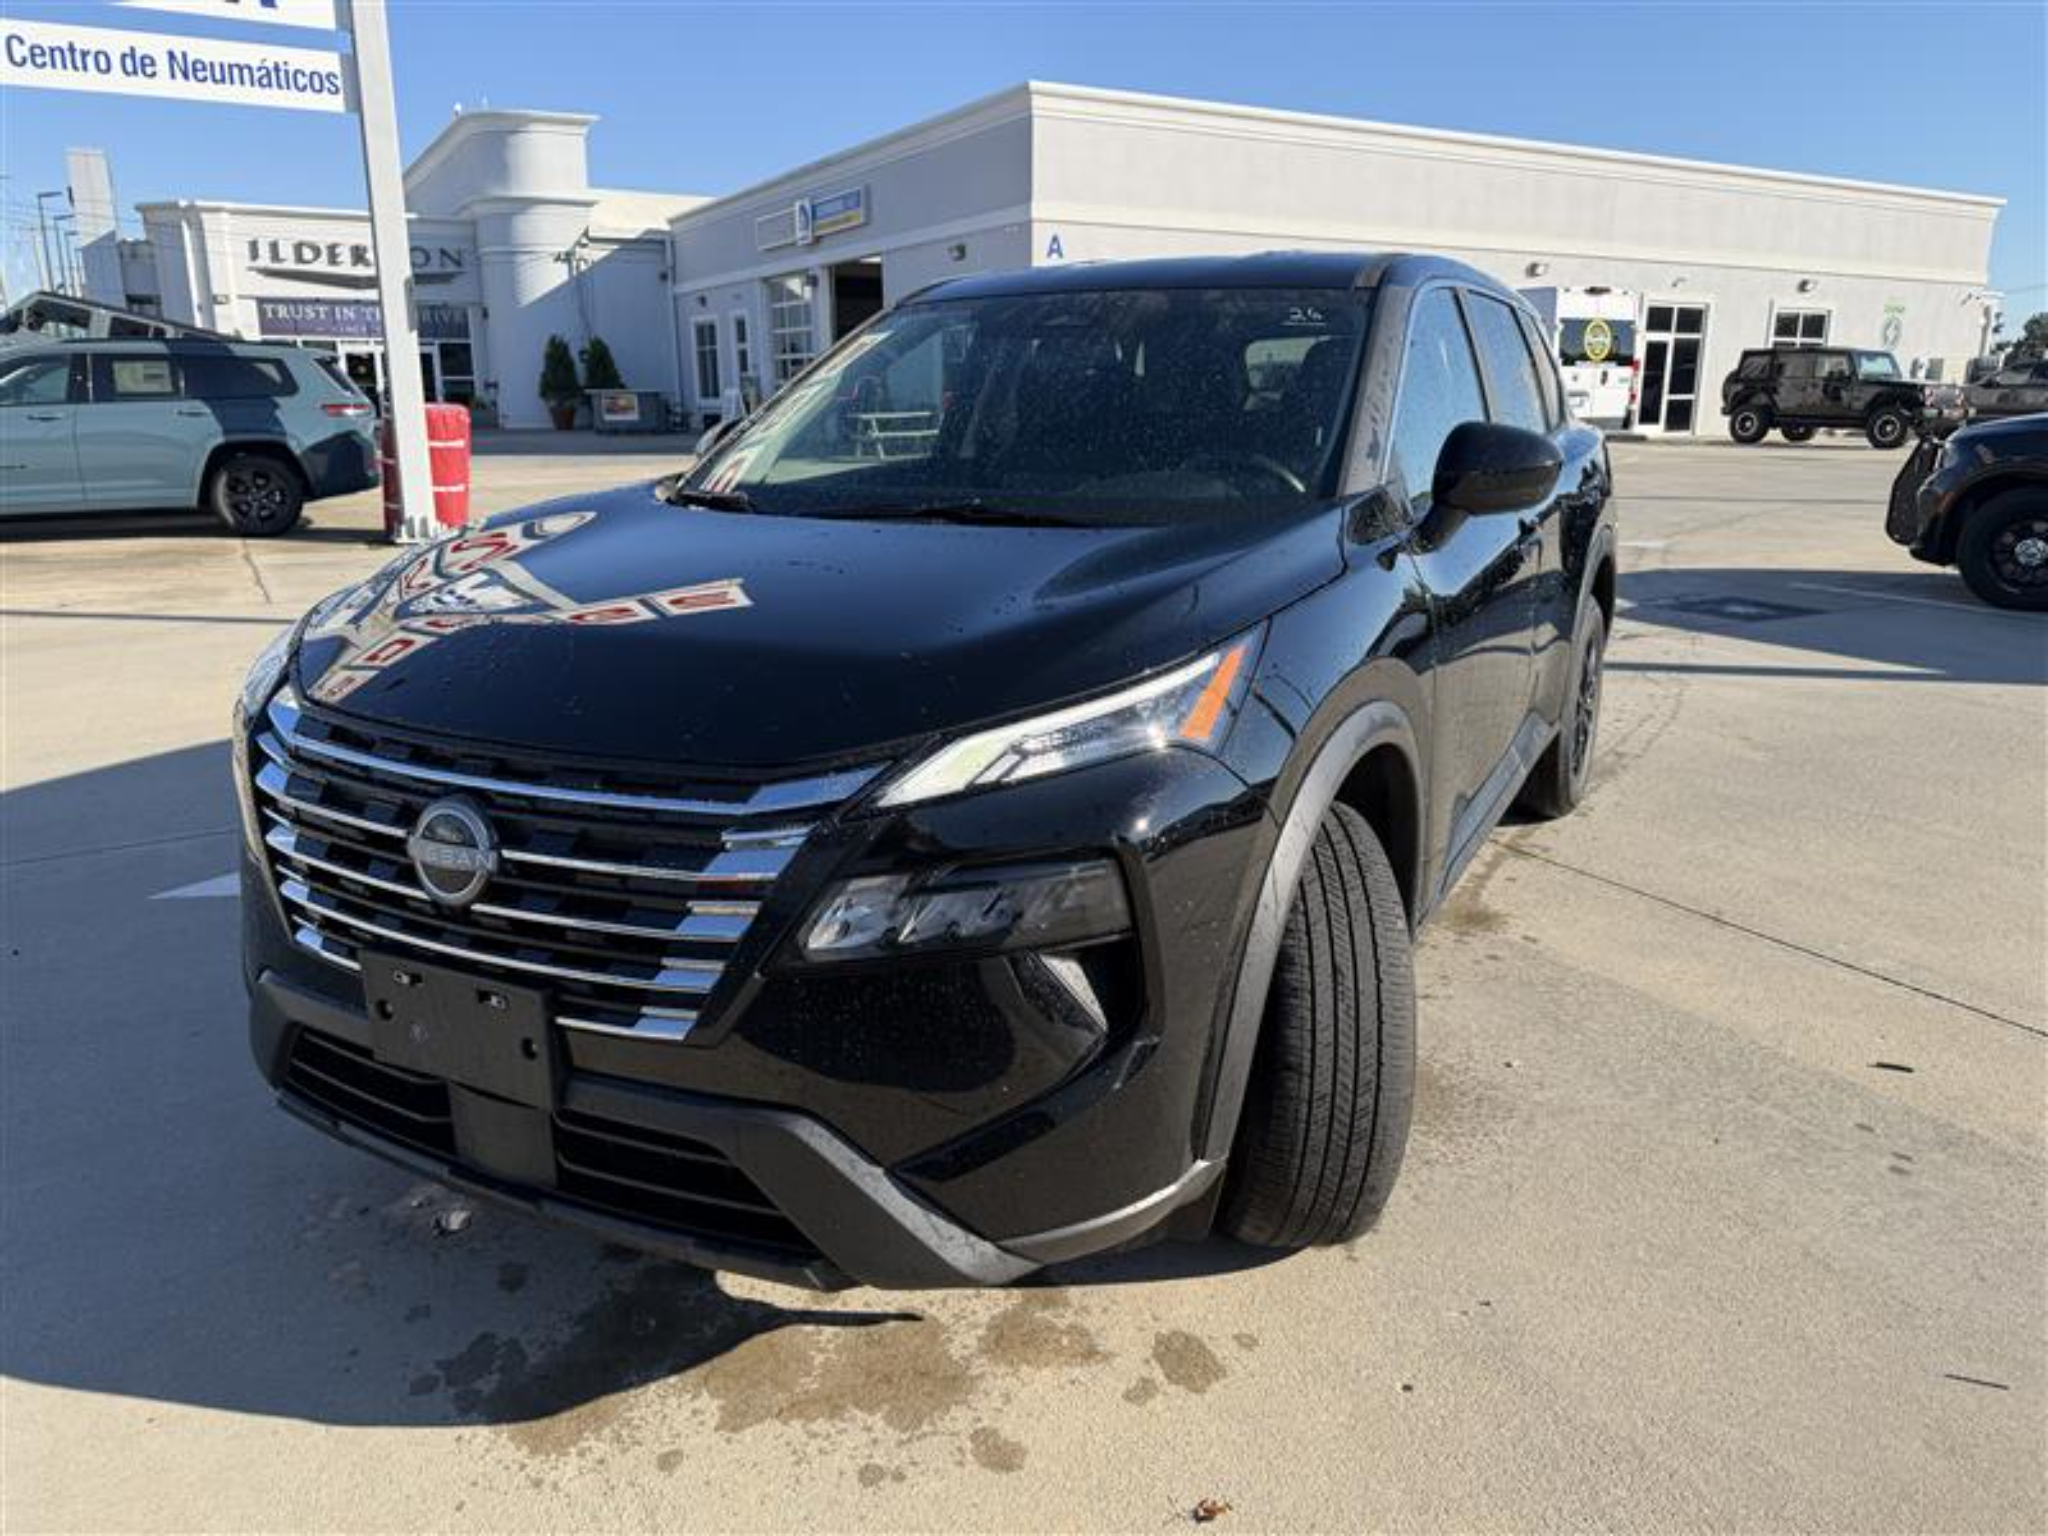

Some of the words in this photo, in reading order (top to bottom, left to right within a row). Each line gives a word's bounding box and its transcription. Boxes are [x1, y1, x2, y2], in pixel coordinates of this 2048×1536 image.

[5, 34, 112, 75] Centro
[121, 46, 157, 78] de
[167, 49, 341, 96] Neumáticos
[248, 239, 463, 269] ILDERON
[1046, 233, 1063, 259] A
[262, 303, 329, 320] TRUST
[335, 306, 355, 321] IN
